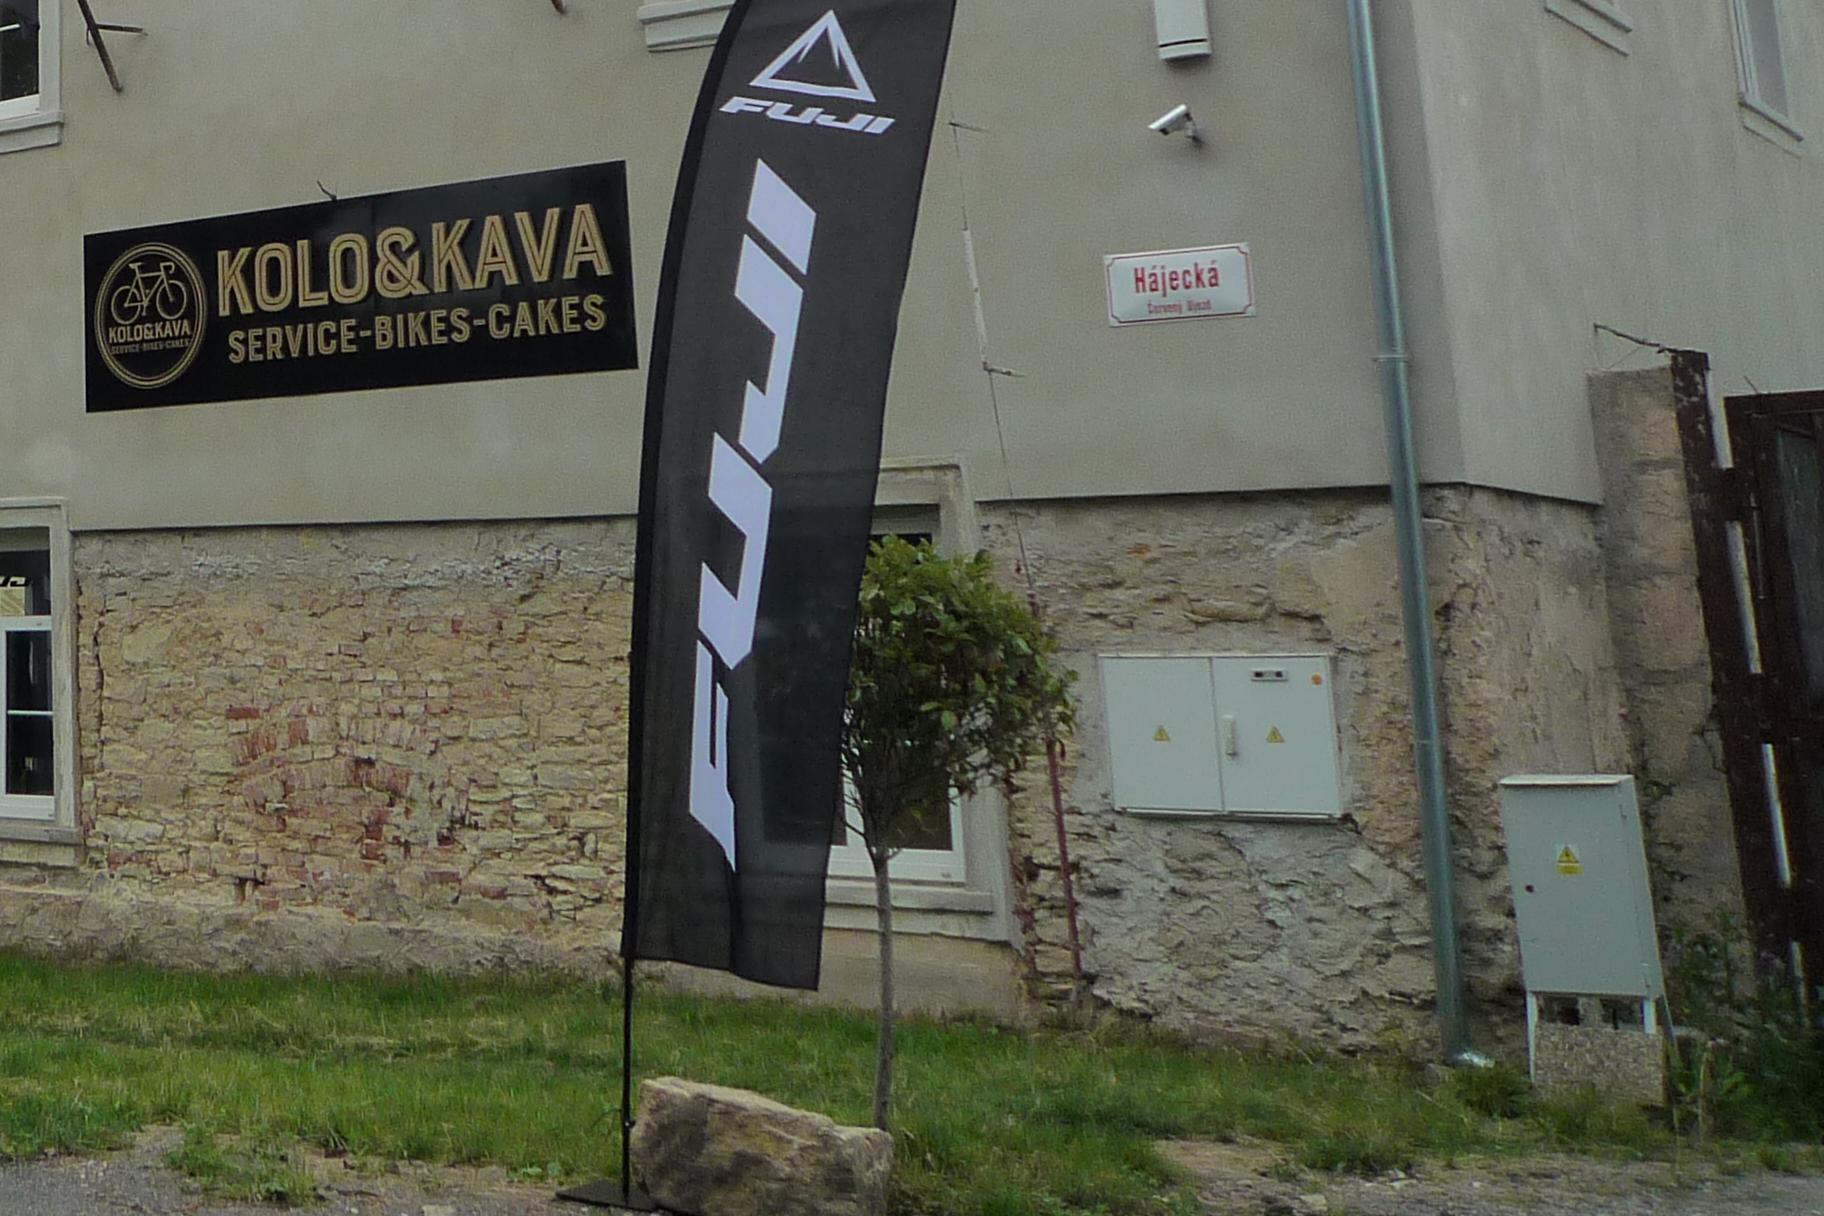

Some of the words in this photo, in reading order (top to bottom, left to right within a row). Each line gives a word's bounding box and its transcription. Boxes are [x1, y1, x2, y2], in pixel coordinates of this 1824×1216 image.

[717, 95, 897, 135] FUJI
[217, 202, 614, 317] KOLO&KAVA
[1133, 260, 1220, 298] Hájecká
[108, 319, 191, 344] KOLO&KAVA
[228, 293, 607, 364] SERVICE-BIKES-CAKES
[689, 158, 817, 873] FUJI
